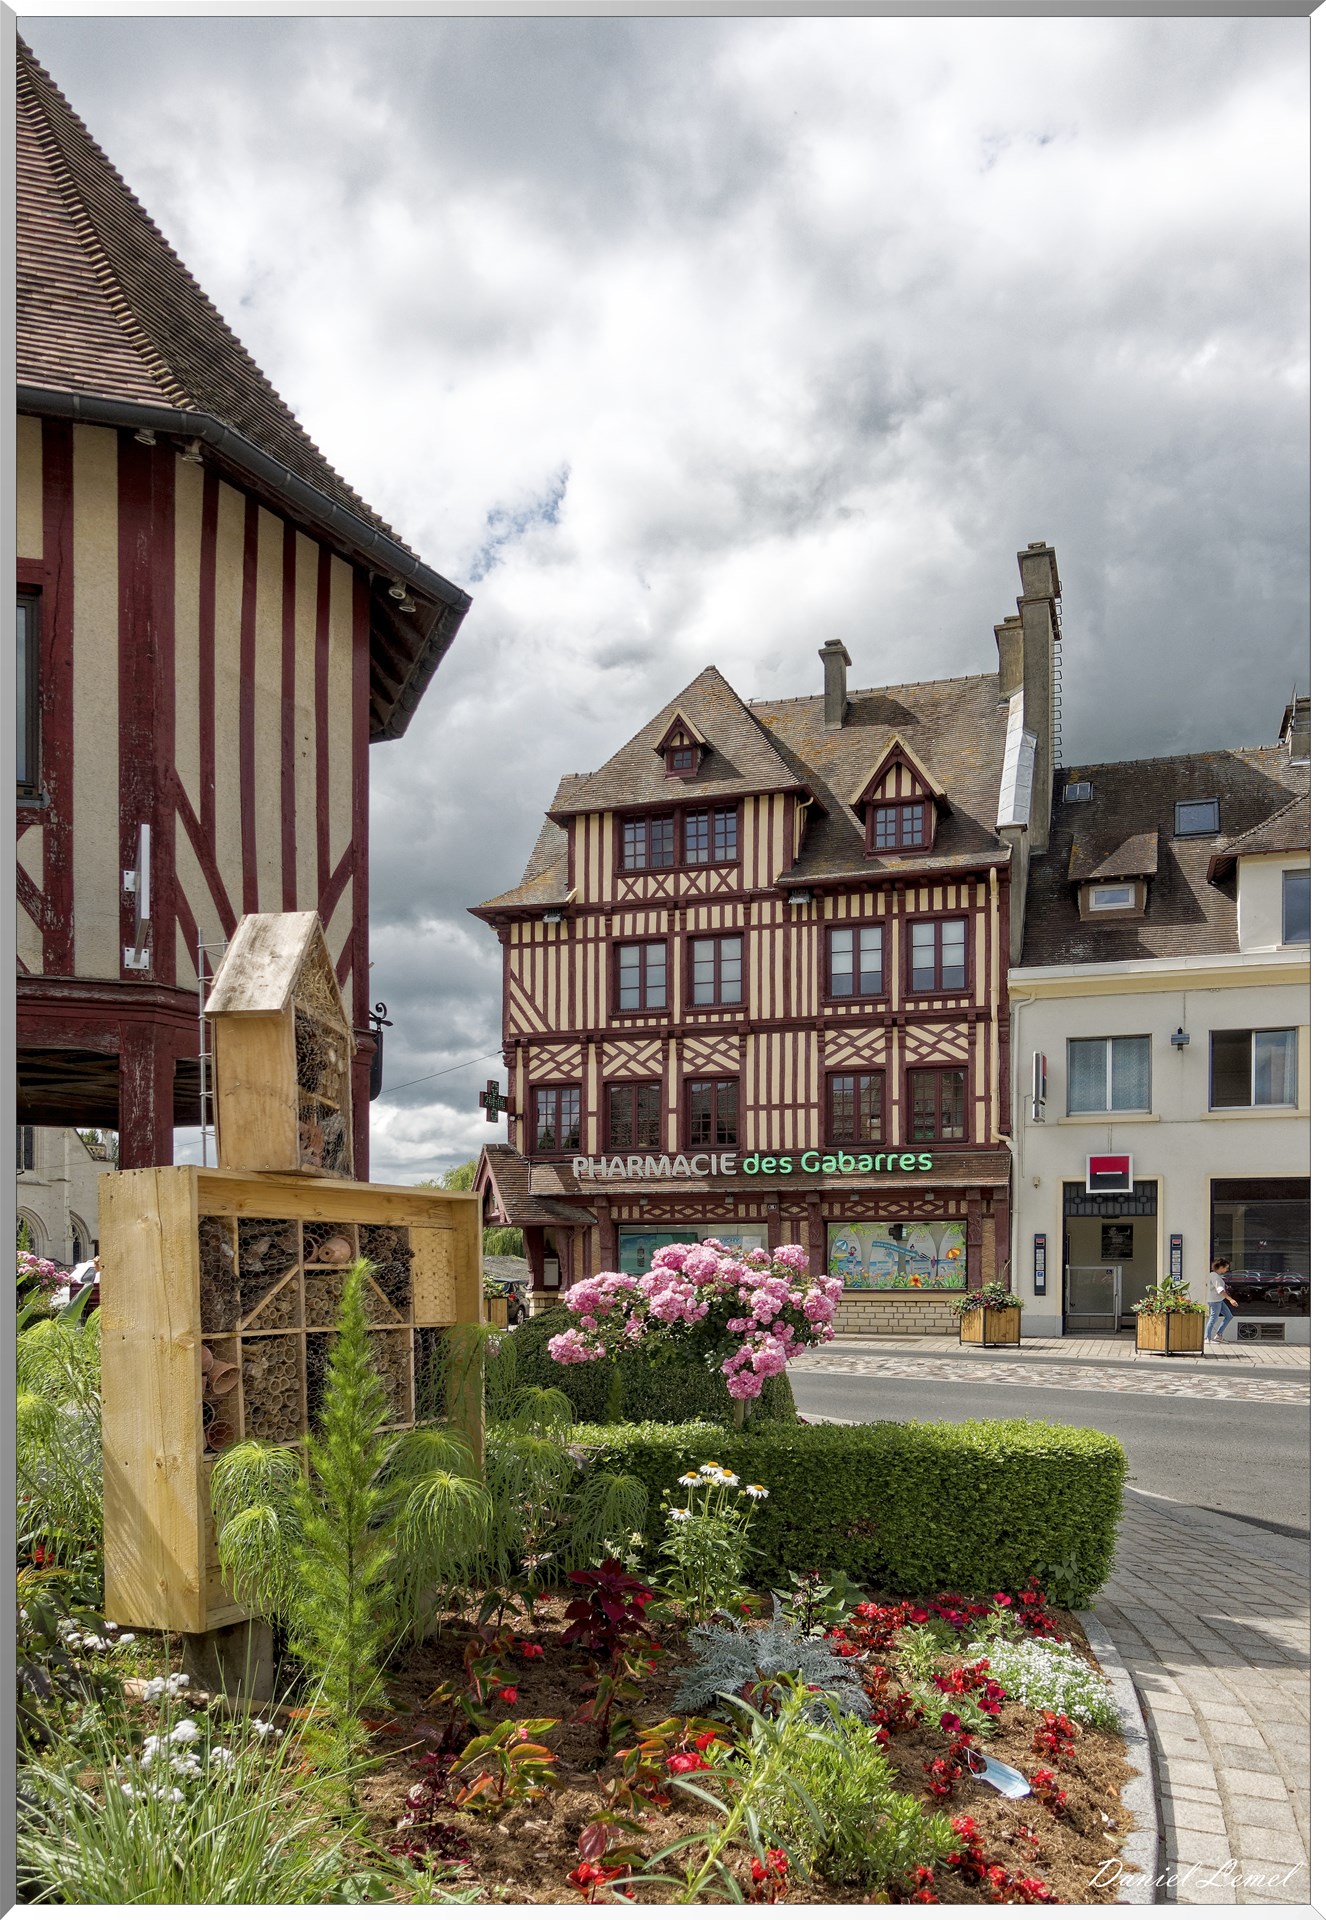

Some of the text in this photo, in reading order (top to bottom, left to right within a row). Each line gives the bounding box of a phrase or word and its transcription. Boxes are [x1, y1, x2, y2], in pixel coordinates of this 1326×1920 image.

[573, 1151, 932, 1177] PHARMACIE des Gabarres
